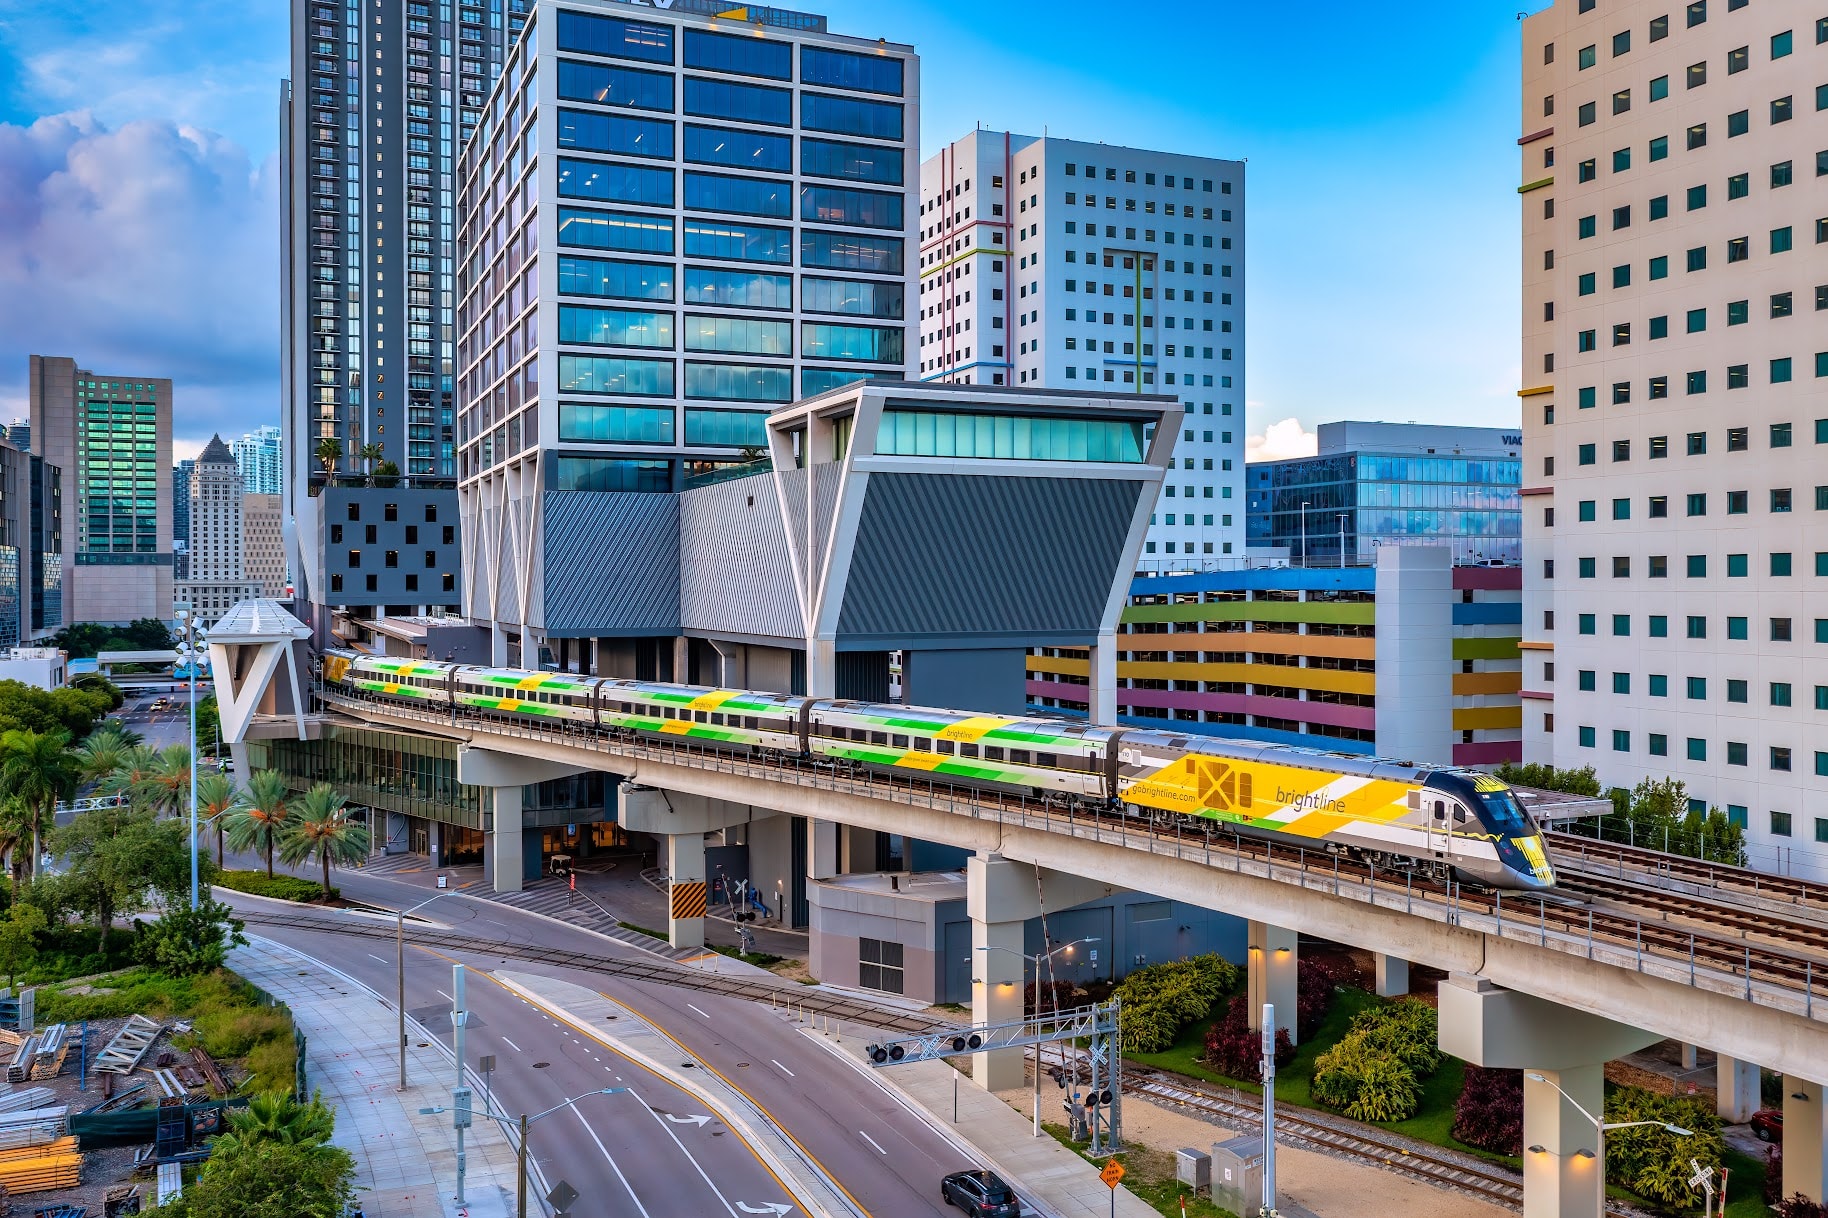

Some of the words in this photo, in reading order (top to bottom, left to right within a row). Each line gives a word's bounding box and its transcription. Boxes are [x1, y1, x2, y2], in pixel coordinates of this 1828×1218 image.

[946, 729, 973, 740] brightline
[1132, 785, 1196, 802] gobrightline.com
[1275, 786, 1346, 813] brightline
[1690, 1168, 1712, 1186] CROSSING
